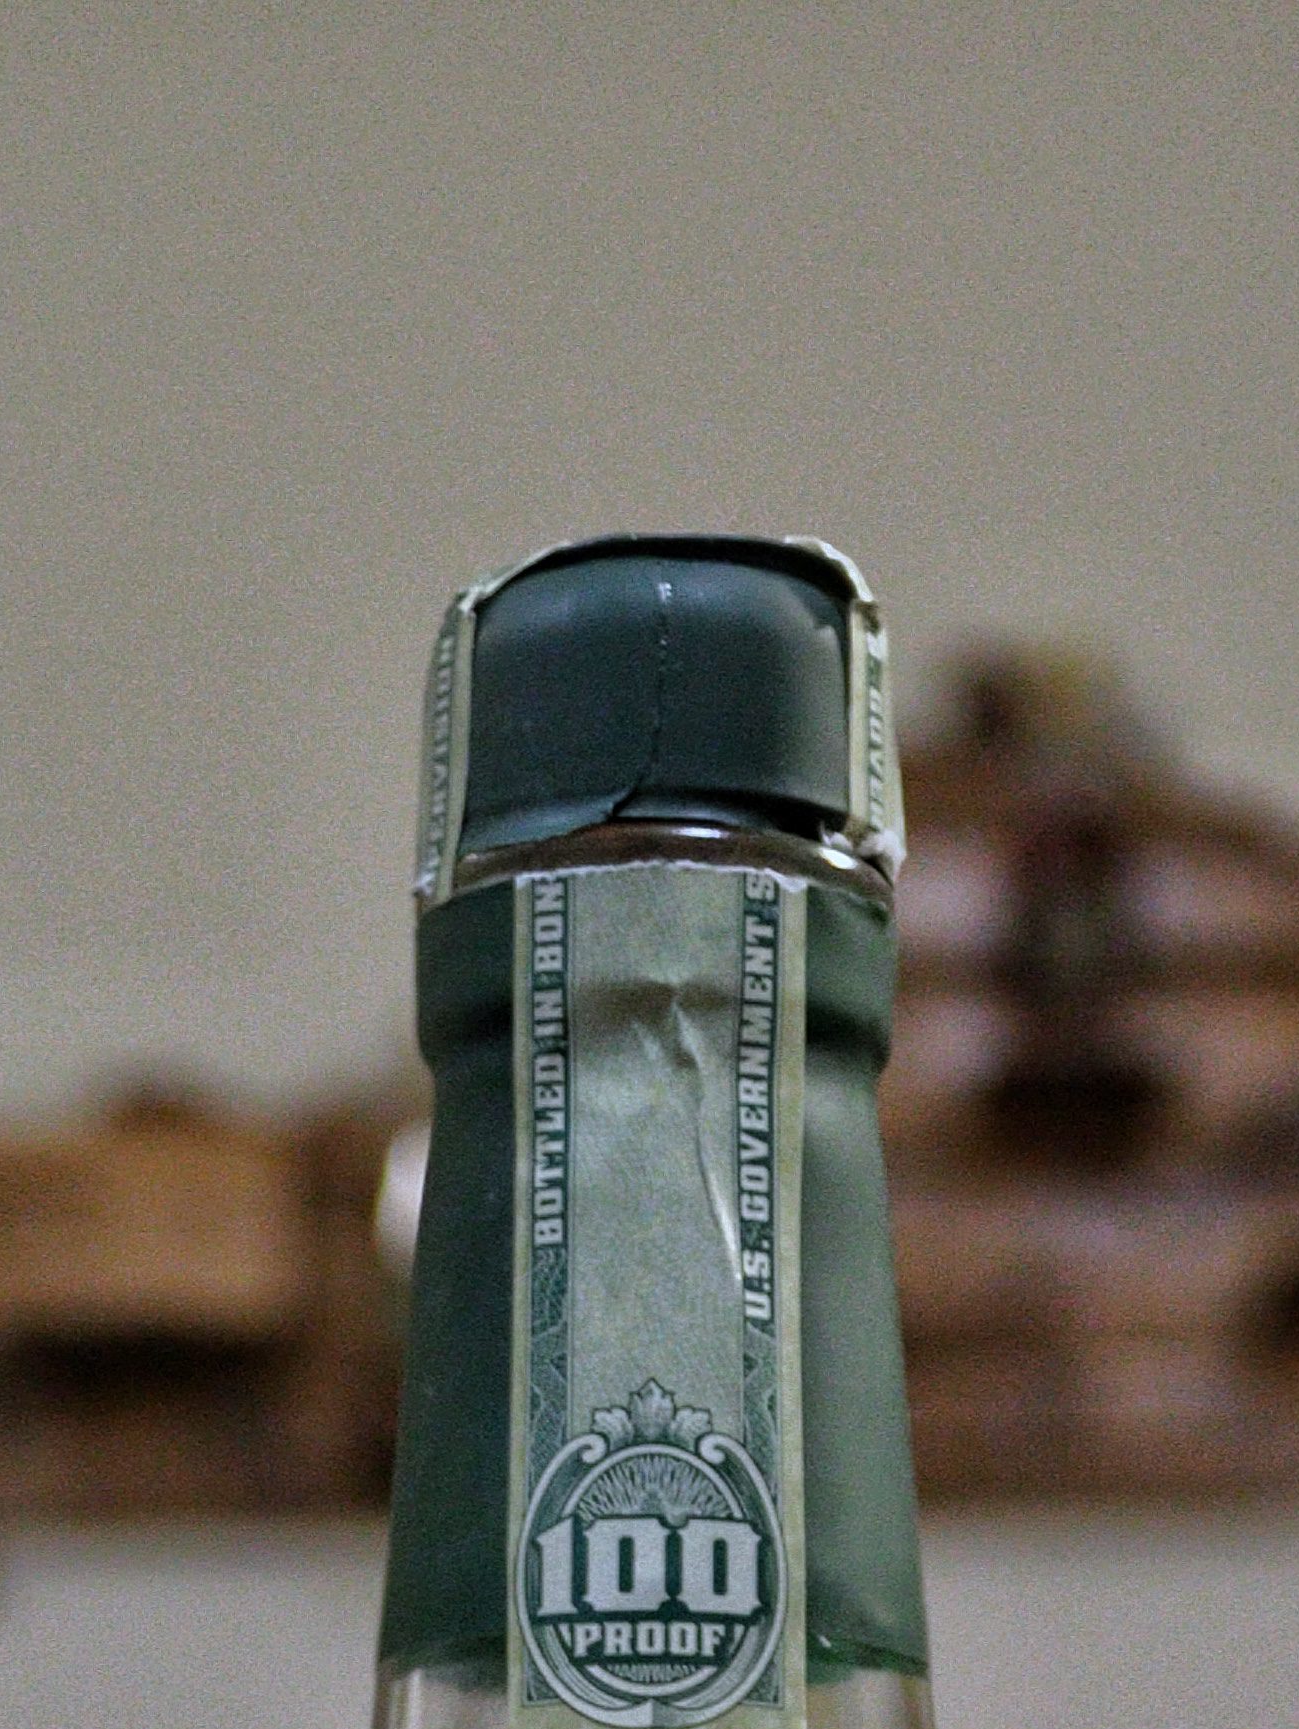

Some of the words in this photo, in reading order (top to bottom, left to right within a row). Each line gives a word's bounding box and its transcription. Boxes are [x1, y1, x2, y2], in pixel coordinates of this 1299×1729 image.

[533, 989, 564, 1037] IN
[740, 914, 773, 1221] GOVERNMENT
[532, 1053, 565, 1246] BOTTLED
[743, 1239, 773, 1322] U.S.
[534, 1517, 763, 1617] 100
[574, 1621, 730, 1658] PROOF
